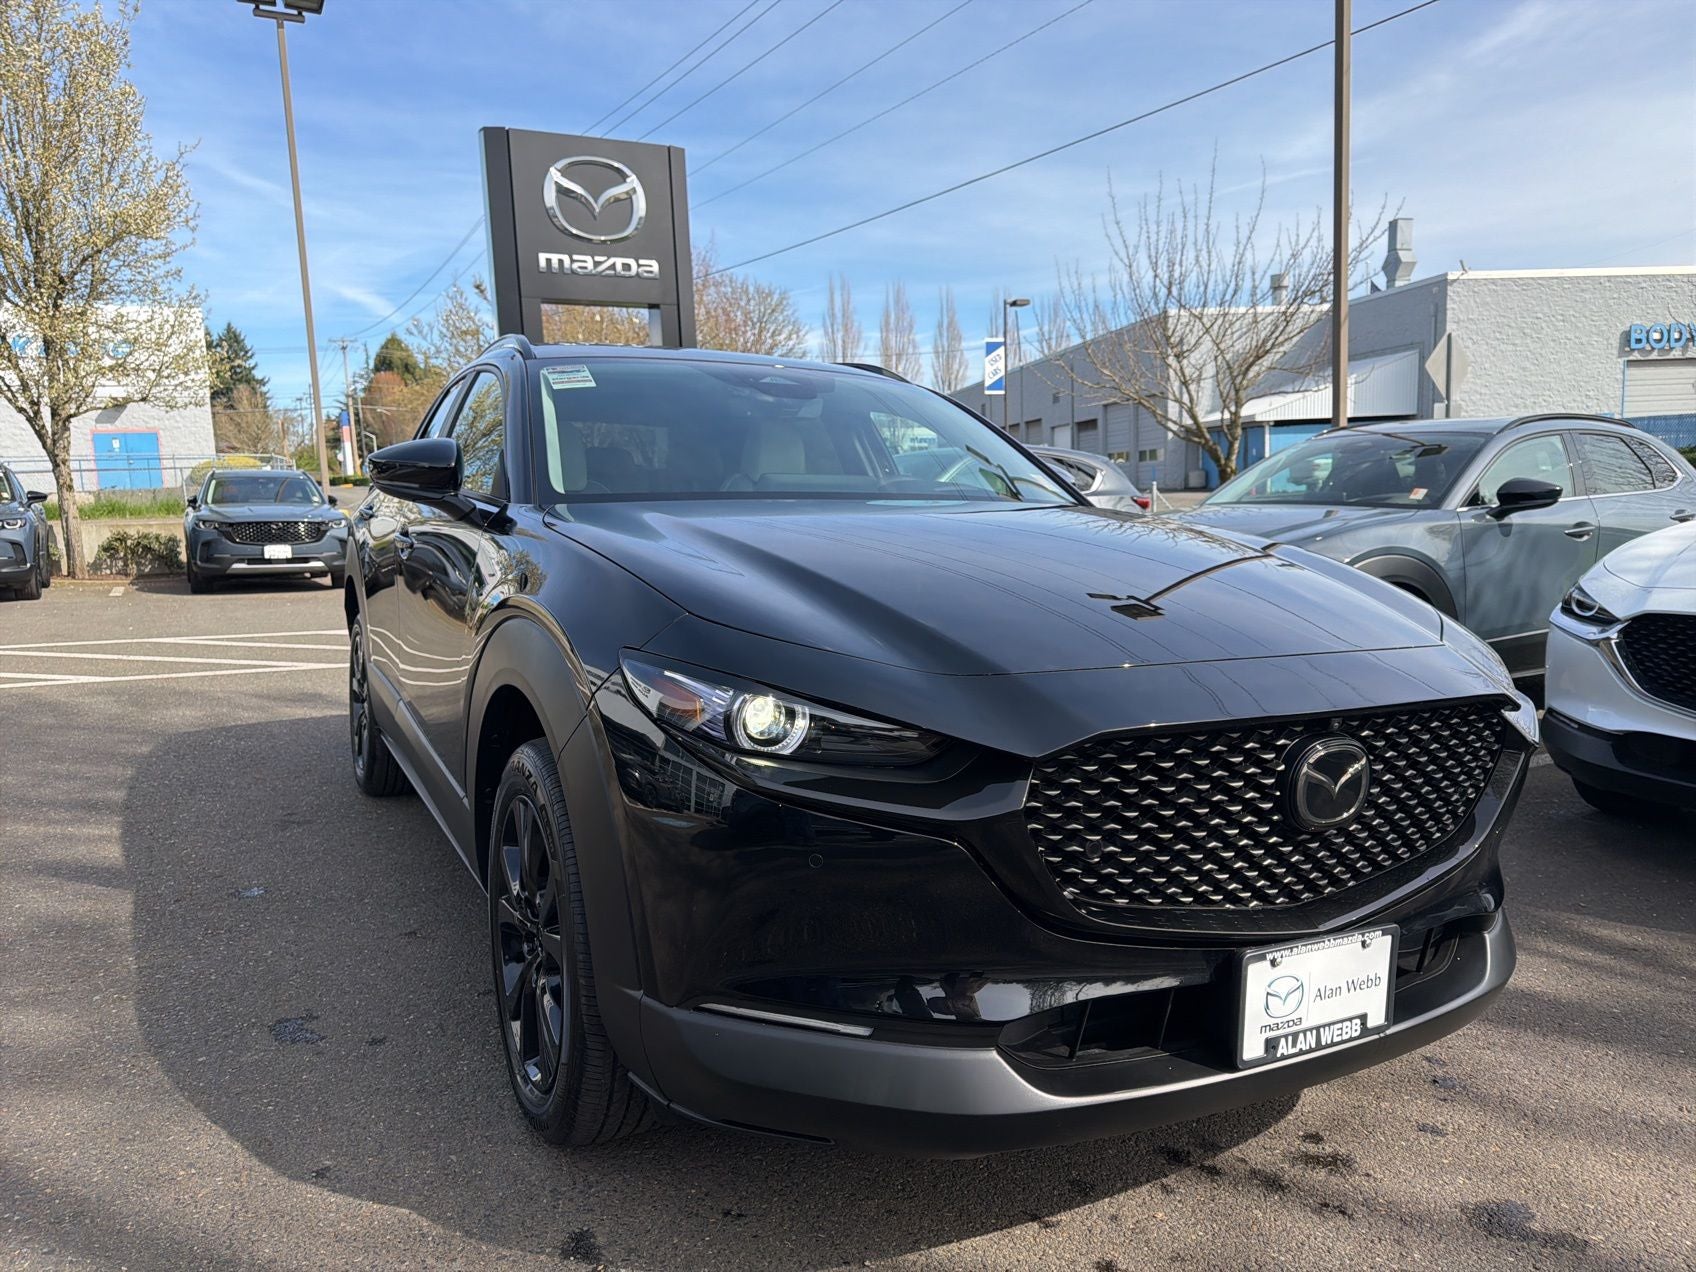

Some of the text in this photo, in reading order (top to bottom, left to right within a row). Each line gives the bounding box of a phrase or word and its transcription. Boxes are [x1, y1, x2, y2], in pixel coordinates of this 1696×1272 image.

[538, 252, 660, 280] mazda
[1266, 930, 1383, 961] www.alanwebbmazda.com
[1312, 972, 1382, 1004] Alan Webb
[1259, 1017, 1303, 1035] mazda
[1276, 1018, 1362, 1058] ALAN WEBB
